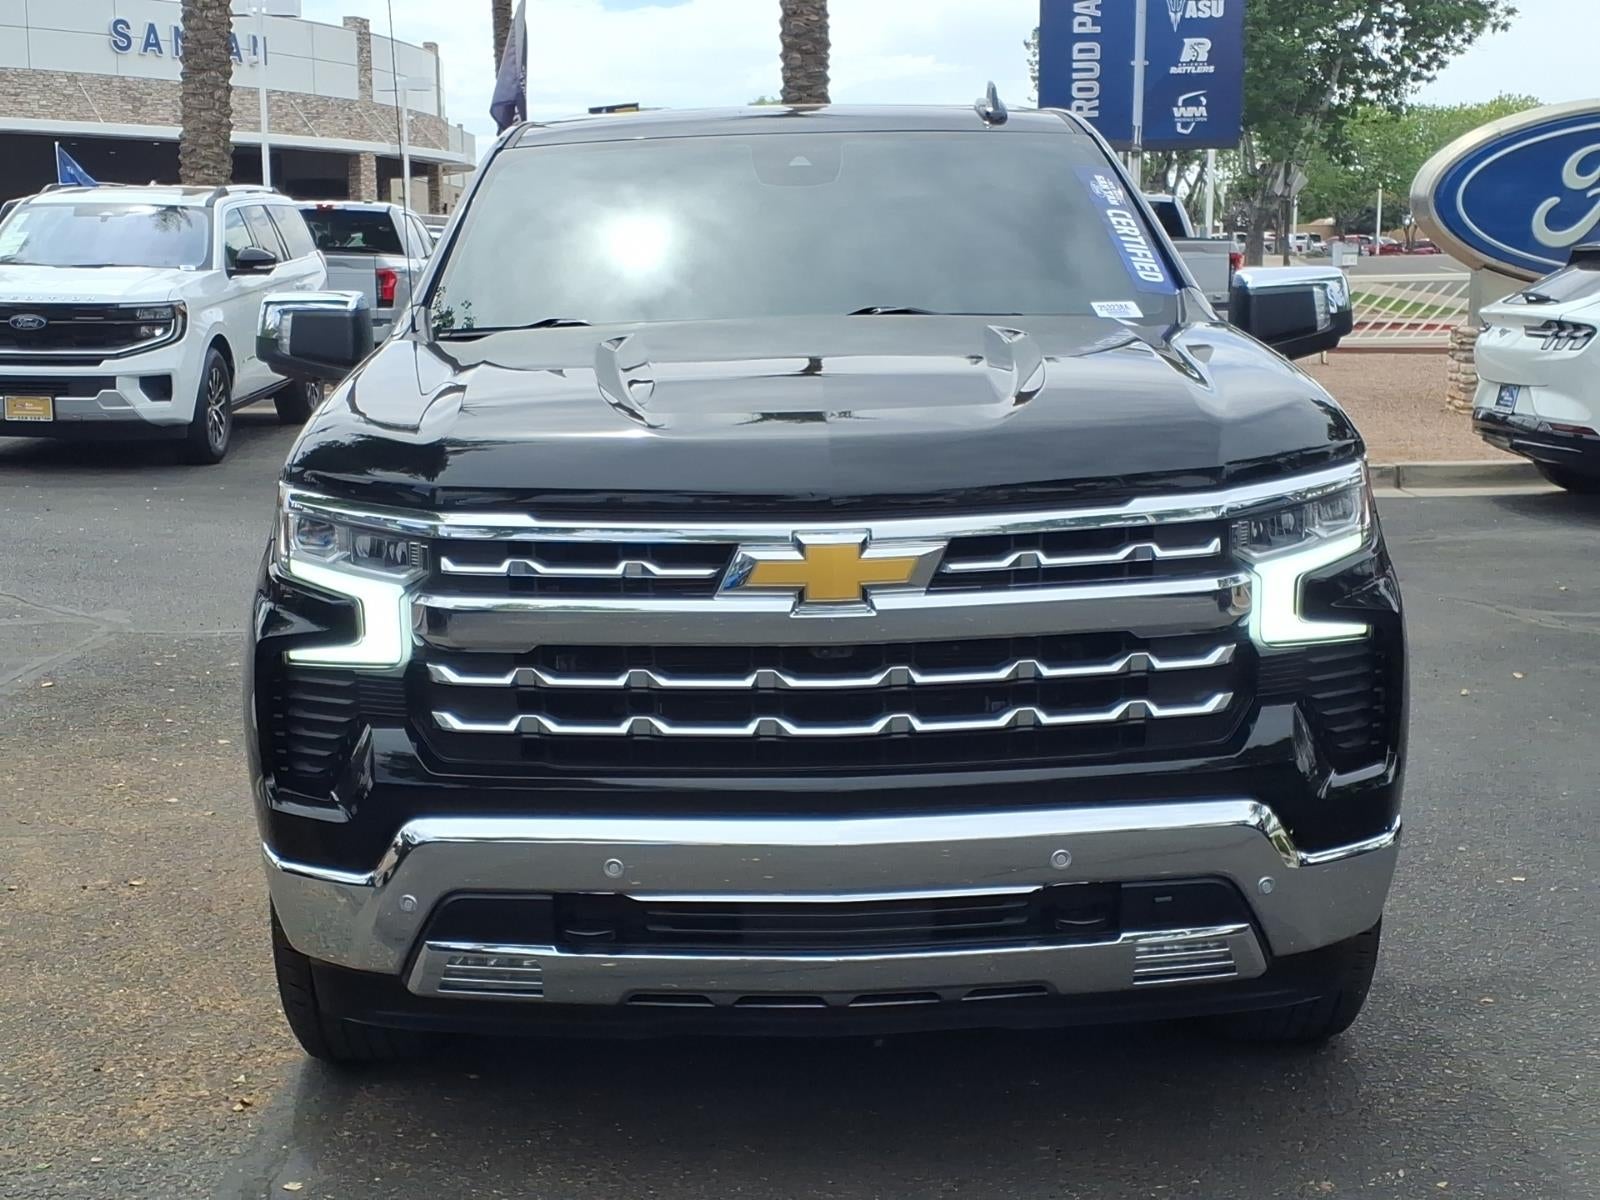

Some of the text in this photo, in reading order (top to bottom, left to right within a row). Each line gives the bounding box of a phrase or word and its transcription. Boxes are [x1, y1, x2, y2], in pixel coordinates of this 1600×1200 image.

[1184, 0, 1225, 19] ASU
[1071, 41, 1101, 118] ROUD
[1169, 65, 1215, 74] RATTLERS
[1106, 209, 1165, 283] CERTIFIED
